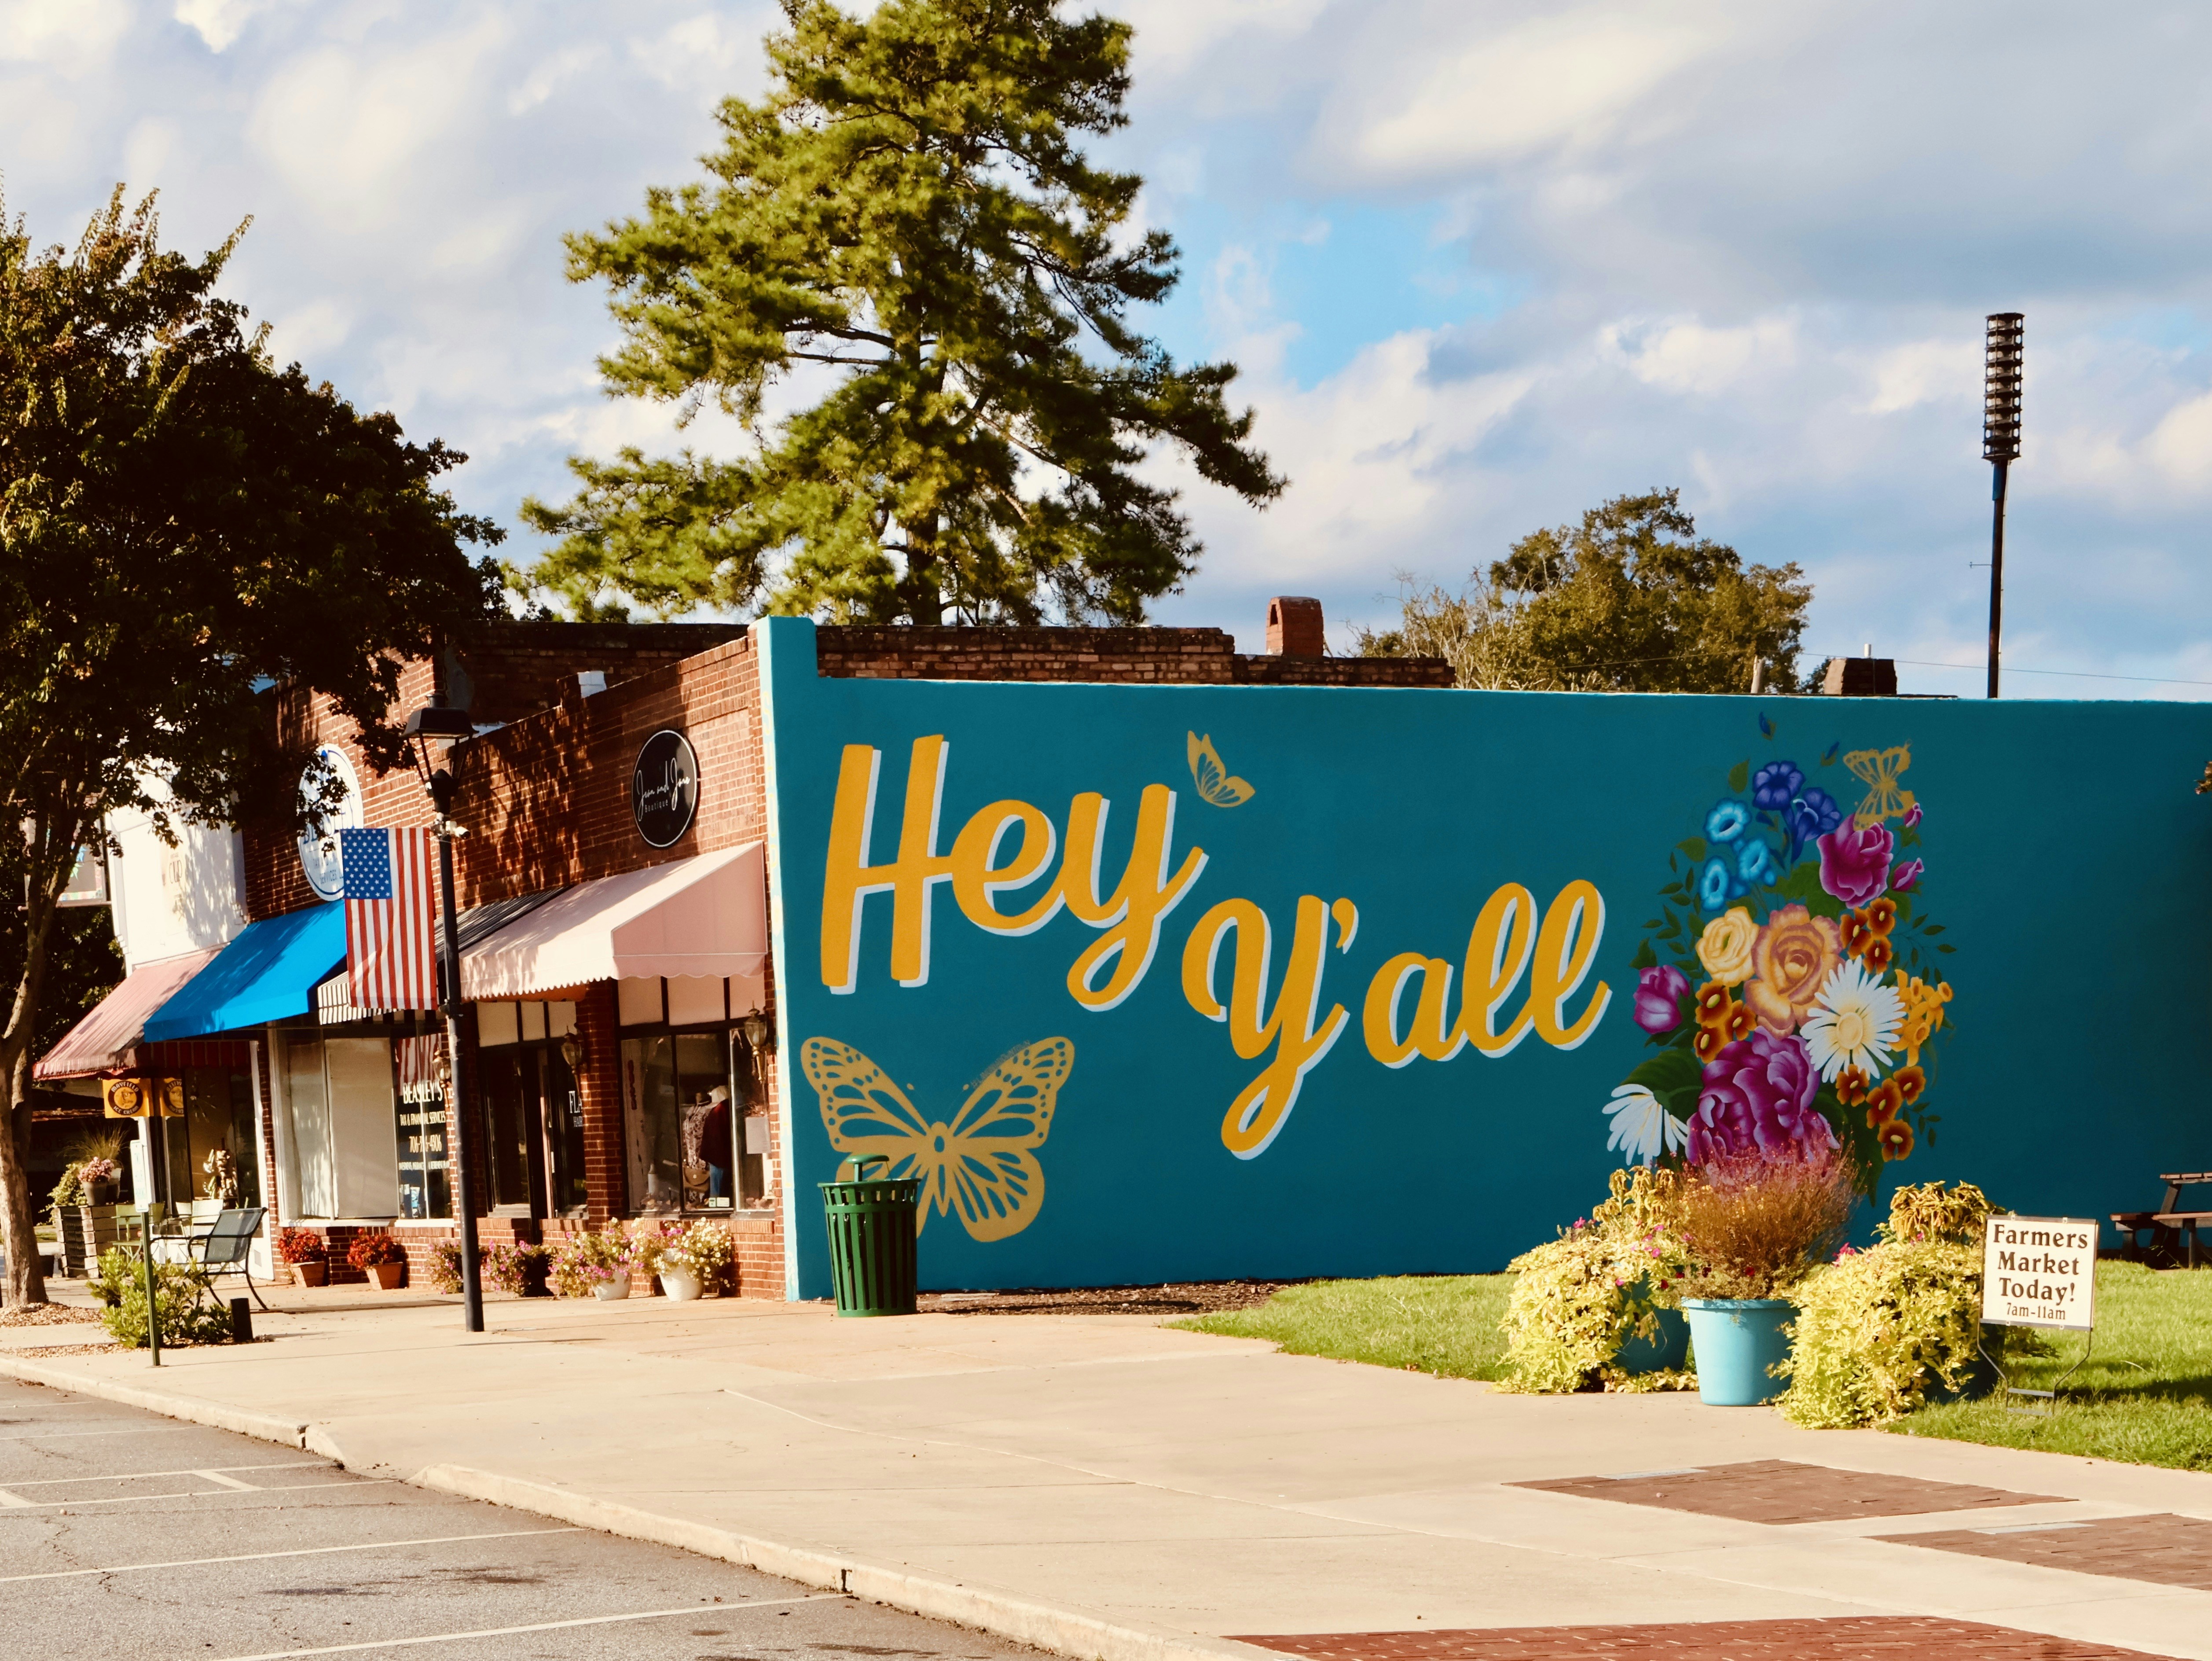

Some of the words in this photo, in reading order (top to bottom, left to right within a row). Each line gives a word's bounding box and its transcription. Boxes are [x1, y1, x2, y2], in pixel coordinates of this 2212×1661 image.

[821, 734, 1208, 1011] Hey
[1182, 879, 1612, 1160] Y'all
[110, 1081, 139, 1093] MAYFIELD
[123, 1105, 139, 1115] CREAM
[1993, 1224, 2088, 1249] Farmers
[1998, 1251, 2080, 1275] Market
[1999, 1277, 2075, 1306] Today!
[2007, 1302, 2066, 1320] 7am-11am
